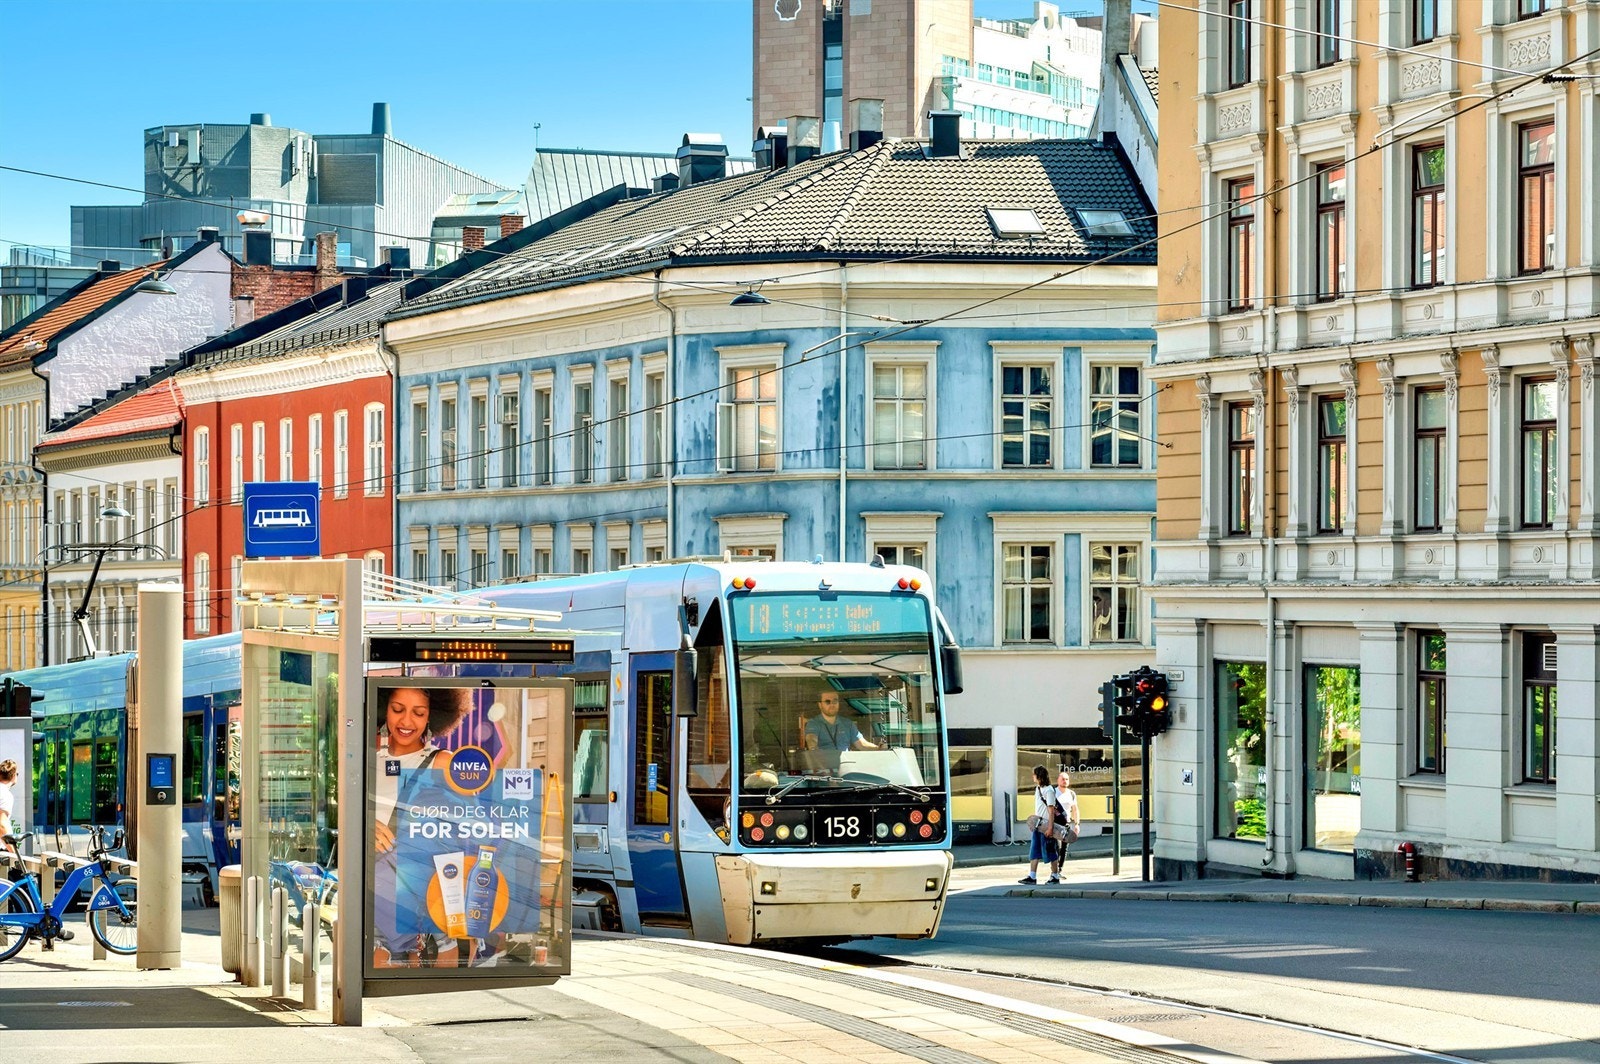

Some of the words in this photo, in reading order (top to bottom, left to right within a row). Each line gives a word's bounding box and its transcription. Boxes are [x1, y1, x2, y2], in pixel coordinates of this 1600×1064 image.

[453, 762, 488, 771] NIVEA
[1056, 764, 1075, 773] The
[1078, 764, 1112, 774] Corner
[460, 772, 480, 780] SUN
[409, 805, 450, 818] GJØR
[453, 805, 486, 818] DEG
[490, 805, 529, 818] KLAR
[409, 822, 453, 838] FOR
[457, 822, 529, 838] SOLEN
[824, 816, 860, 838] 158
[468, 909, 481, 919] 30
